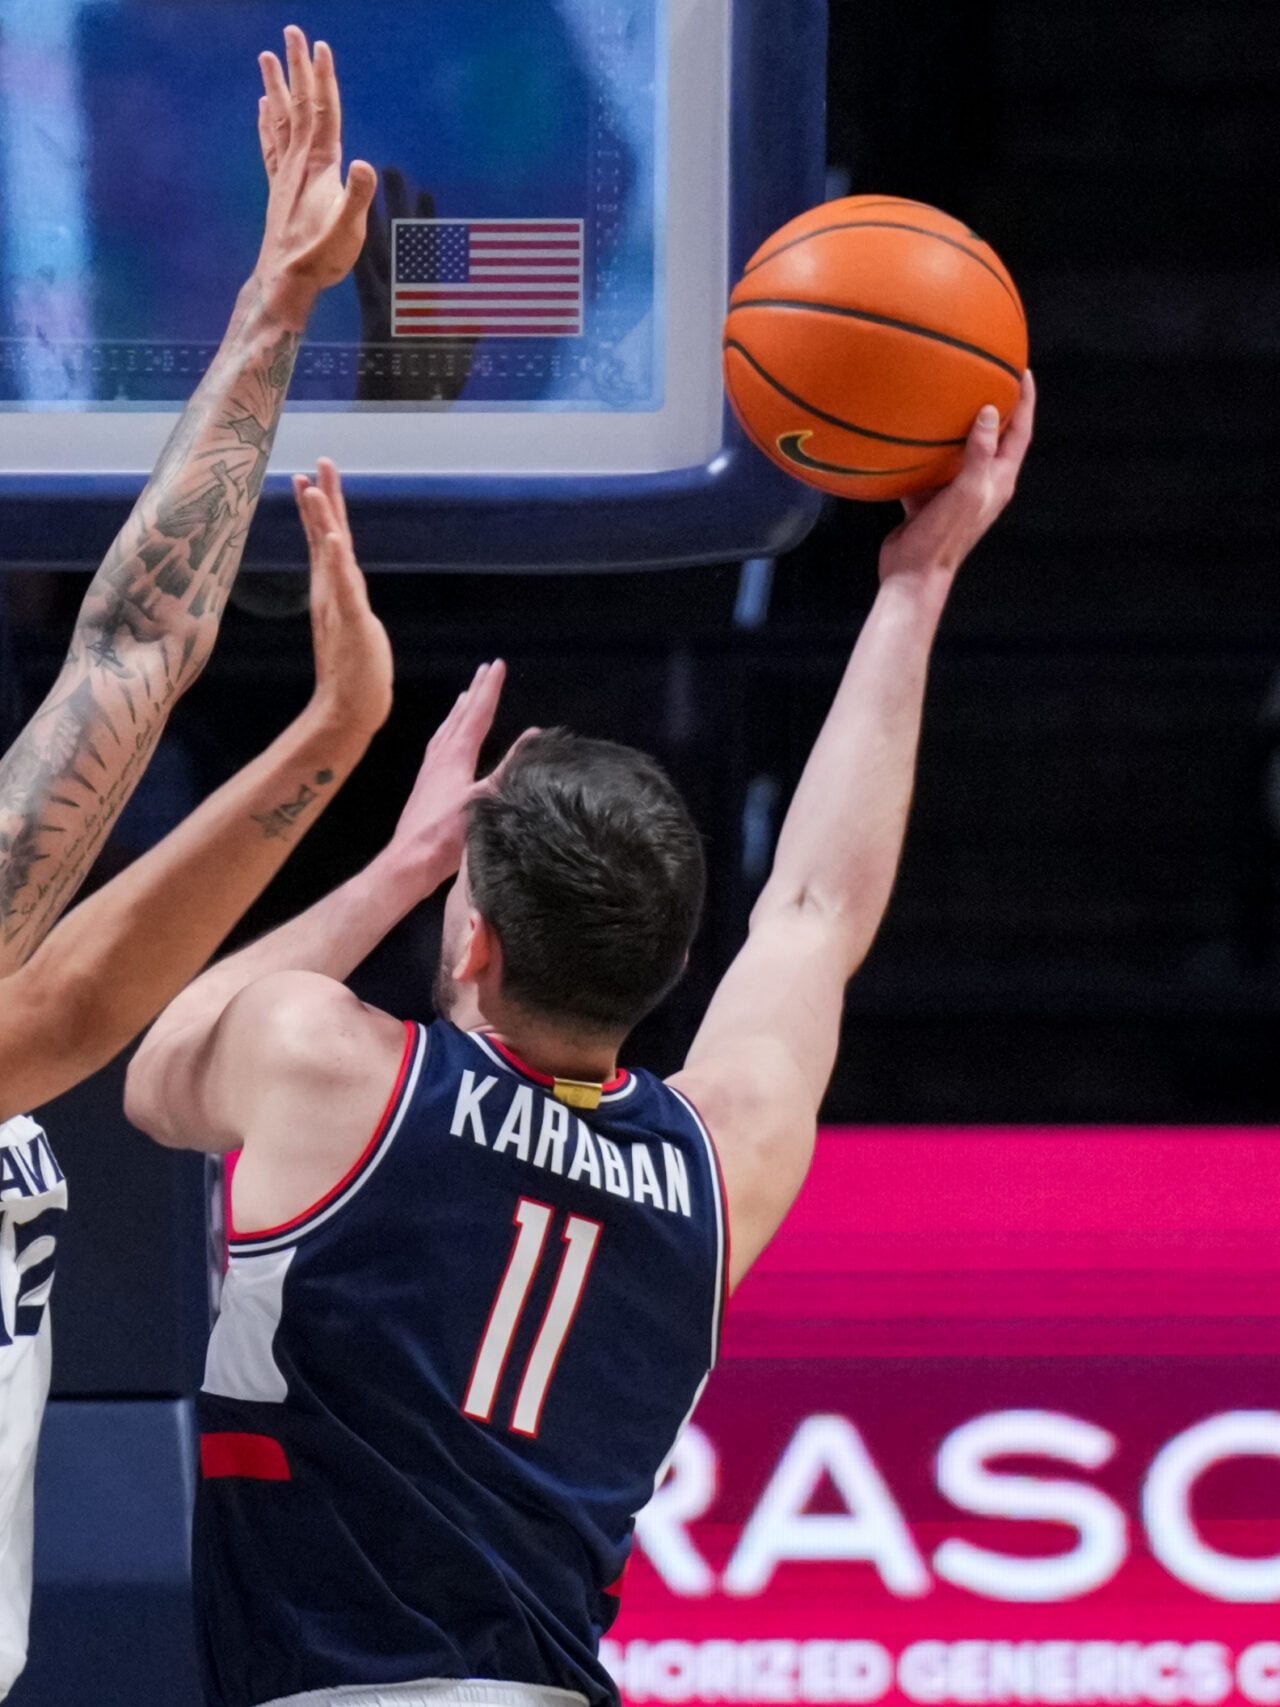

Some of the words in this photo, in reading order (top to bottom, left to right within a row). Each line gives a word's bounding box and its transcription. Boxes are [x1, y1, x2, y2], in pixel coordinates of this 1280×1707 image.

[449, 1068, 692, 1218] KARABAN
[460, 1194, 605, 1440] 11
[896, 1638, 1233, 1705] GENERICS
